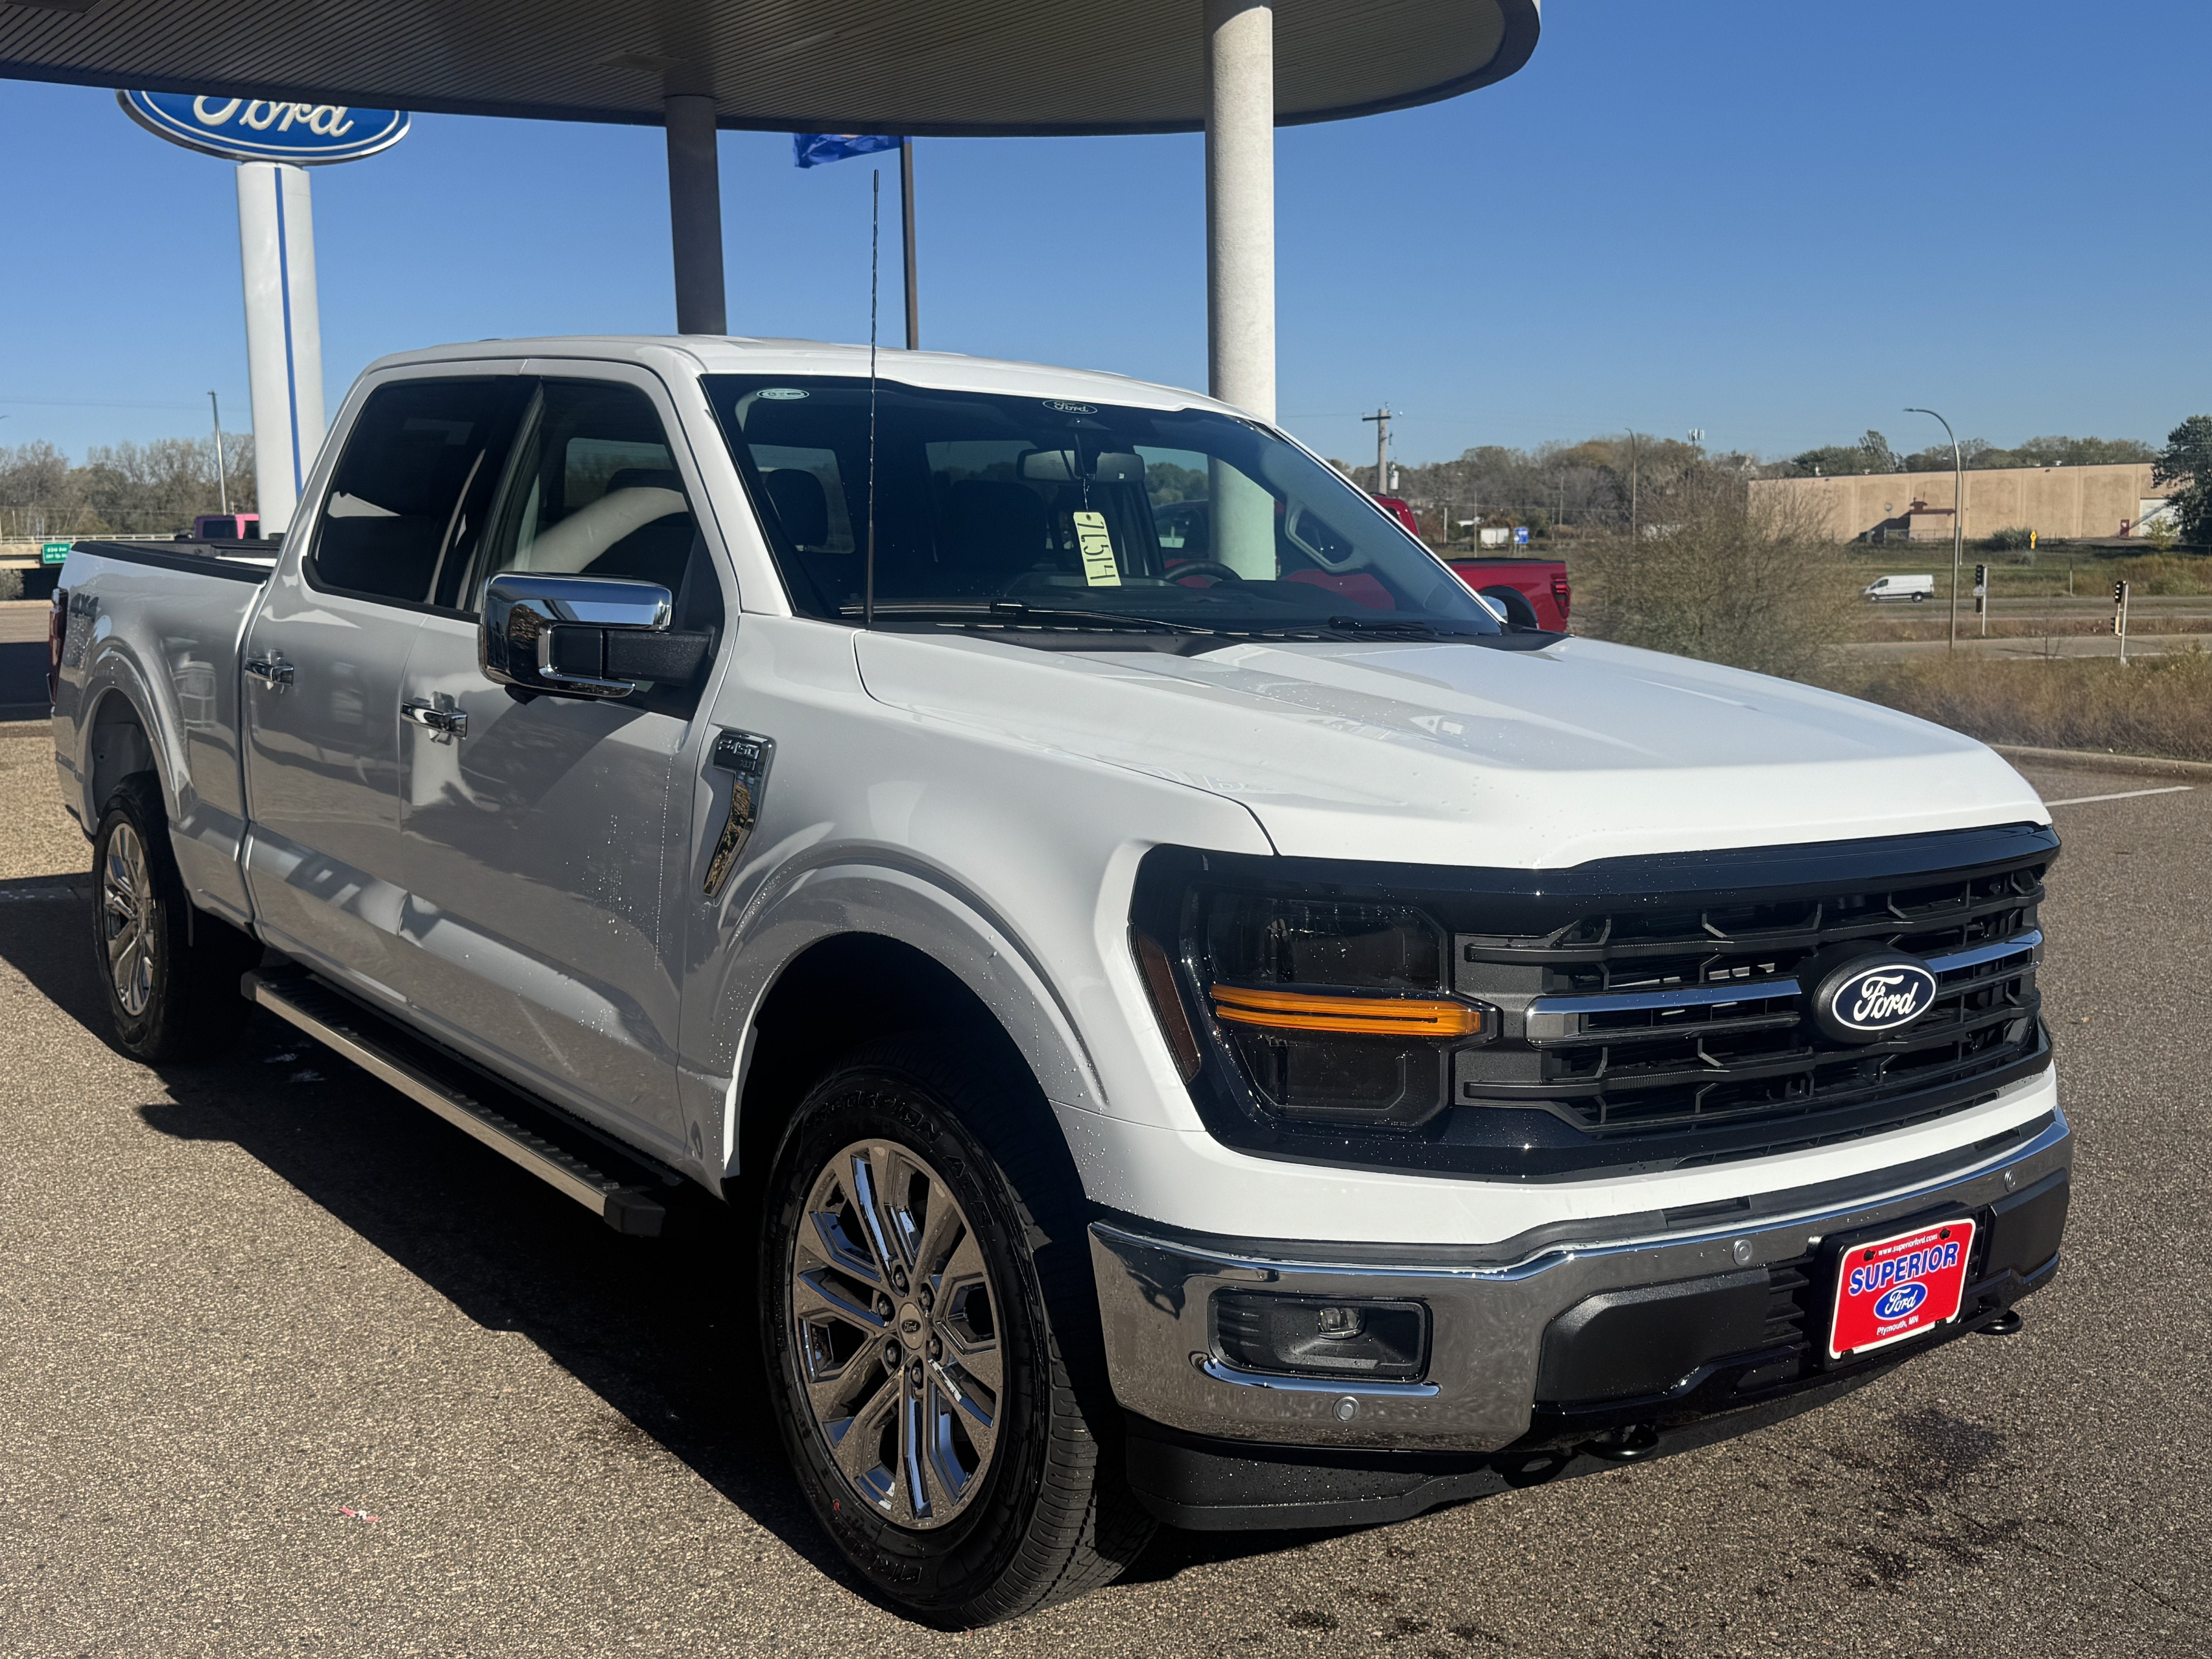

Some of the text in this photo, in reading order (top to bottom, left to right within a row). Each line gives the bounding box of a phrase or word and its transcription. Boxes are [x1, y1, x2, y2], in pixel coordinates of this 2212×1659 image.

[1054, 401, 1089, 412] Ford
[1077, 521, 1116, 580] 76514
[1853, 975, 1919, 1022] Ford
[1879, 1233, 1938, 1256] www.superiorford.com
[1849, 1241, 1960, 1296] SUPERIOR
[1885, 1288, 1918, 1314] Ford
[903, 1321, 917, 1332] Ford
[1908, 1315, 1919, 1325] MN
